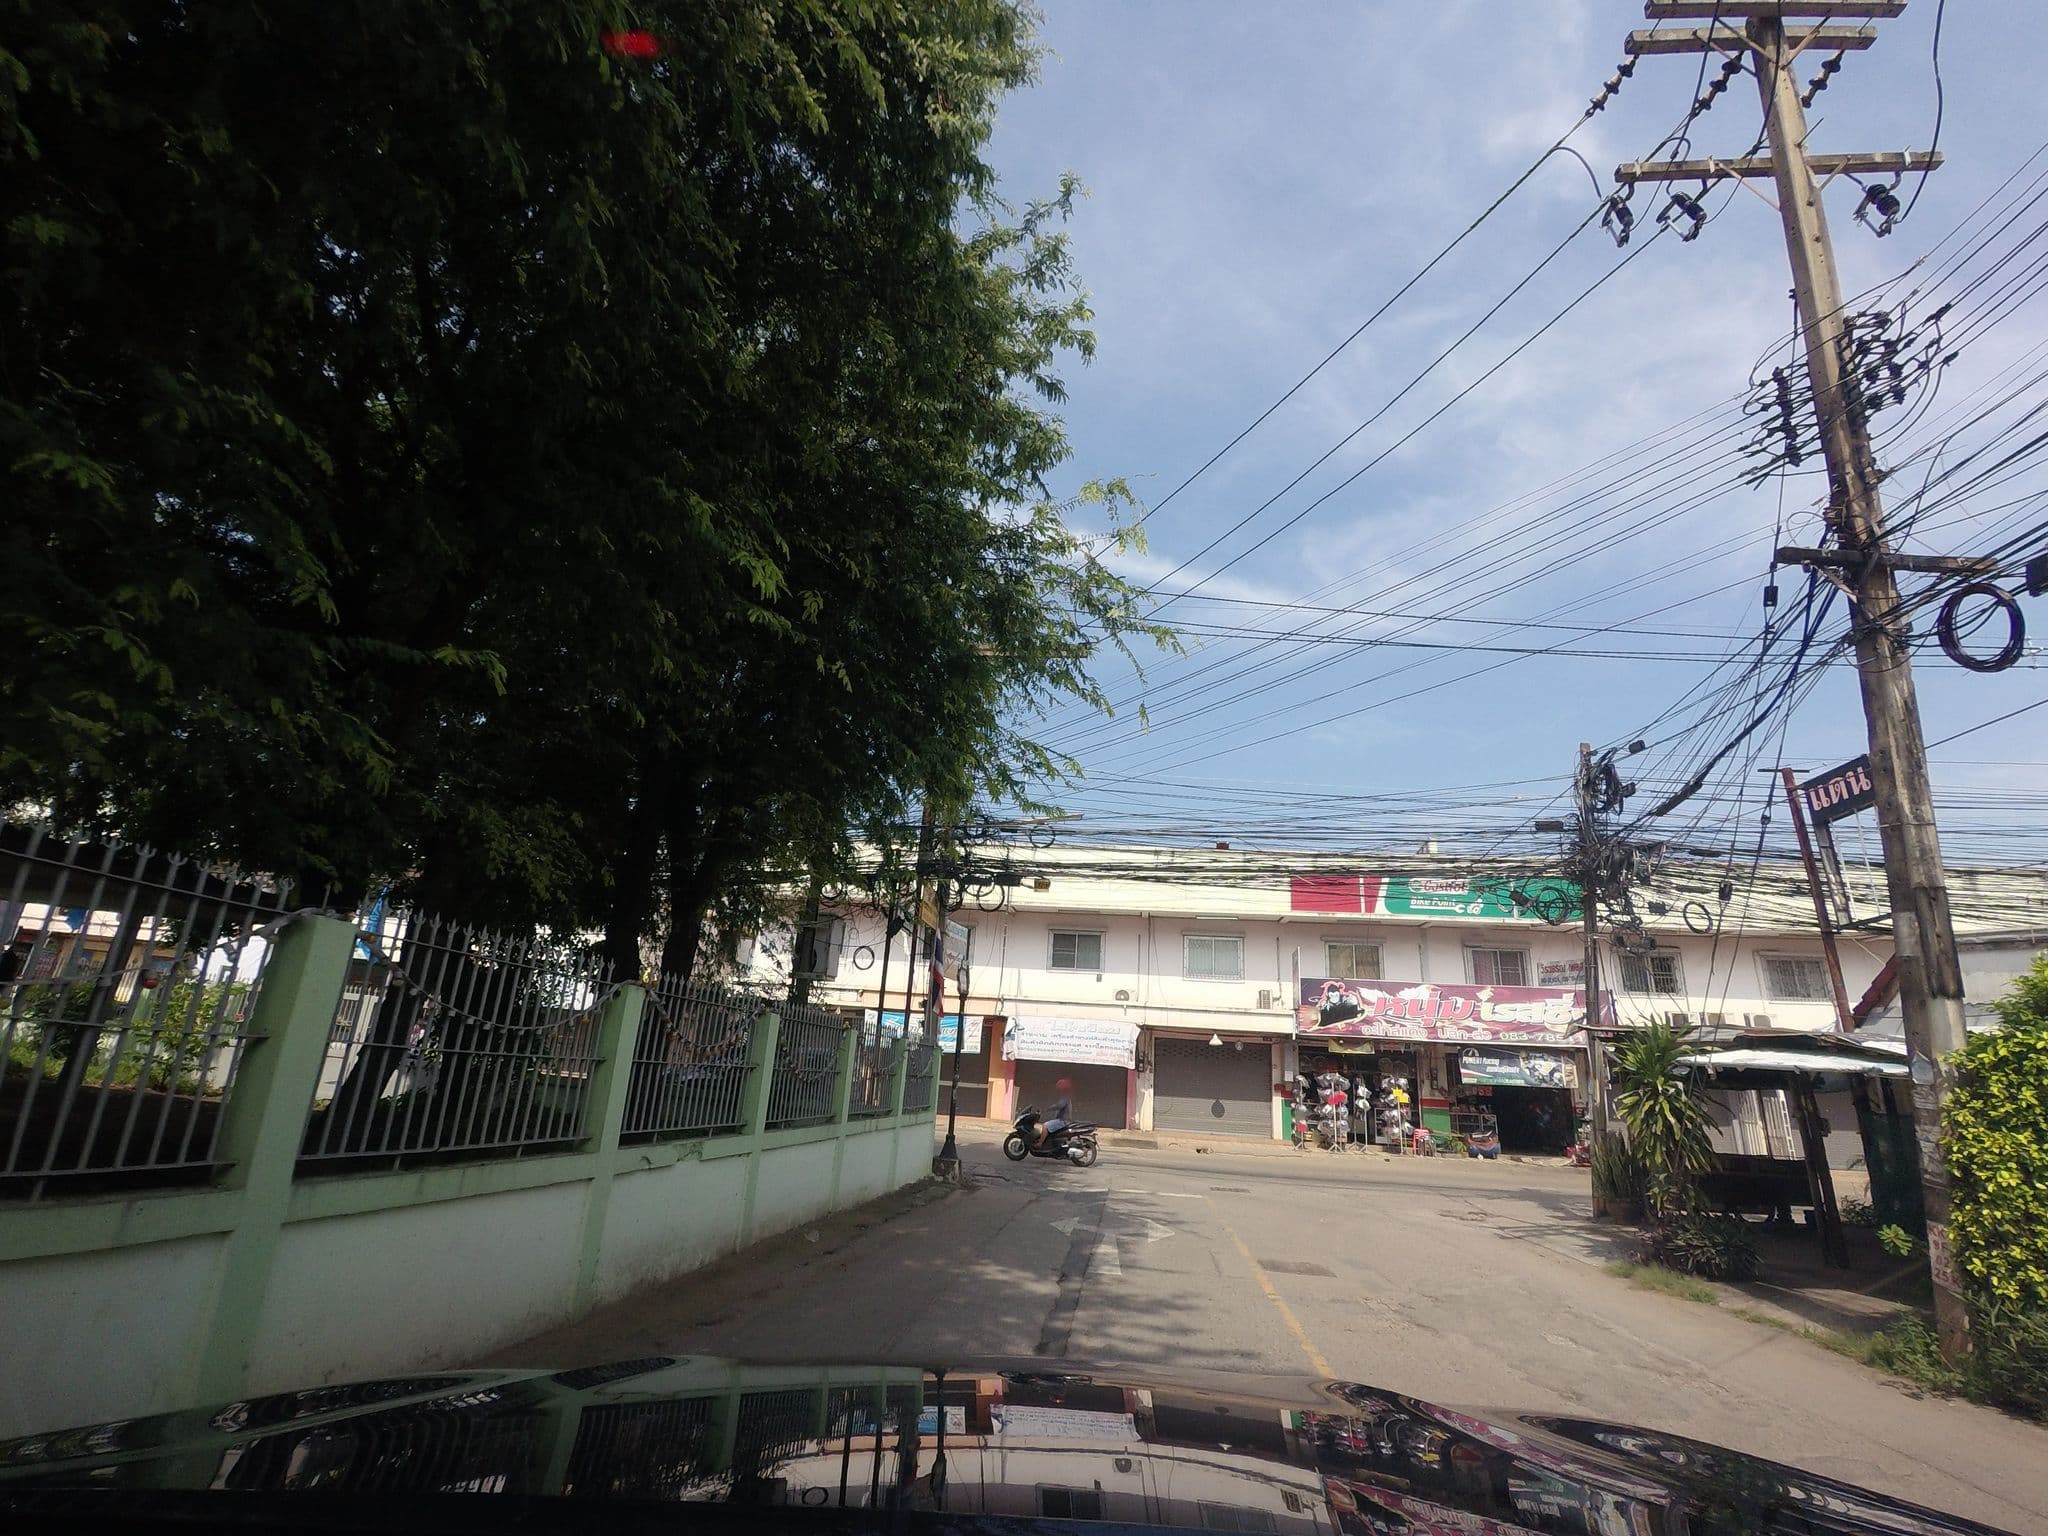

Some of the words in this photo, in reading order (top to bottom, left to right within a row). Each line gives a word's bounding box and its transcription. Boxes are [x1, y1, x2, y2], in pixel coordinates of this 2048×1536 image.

[1374, 991, 1475, 1028] หนุ่ม
[1438, 1024, 1493, 1040] ปลีก-ส่ง
